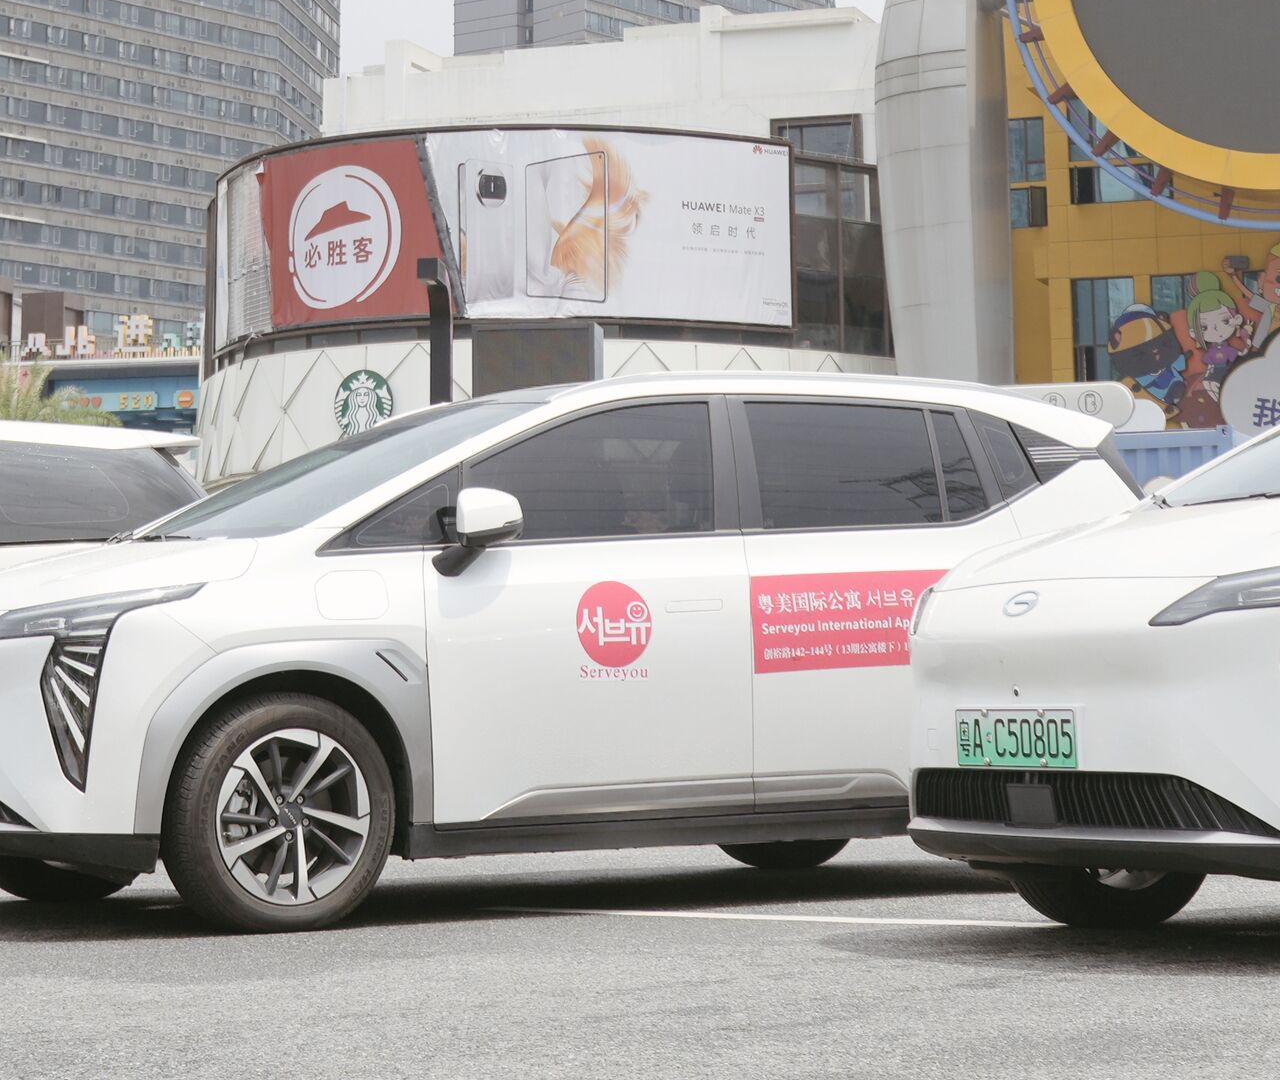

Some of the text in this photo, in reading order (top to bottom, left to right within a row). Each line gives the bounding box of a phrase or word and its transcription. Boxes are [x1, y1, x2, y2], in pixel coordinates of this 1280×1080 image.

[681, 200, 765, 217] HUAWEI Mate X3
[691, 222, 756, 240] 领启时代
[304, 236, 373, 269] 必胜客
[758, 588, 916, 615] 粤美国际公寓 서브유
[578, 601, 652, 646] 서브유
[762, 622, 815, 636] Serveyou
[818, 616, 892, 632] International
[579, 664, 648, 682] Serveyou
